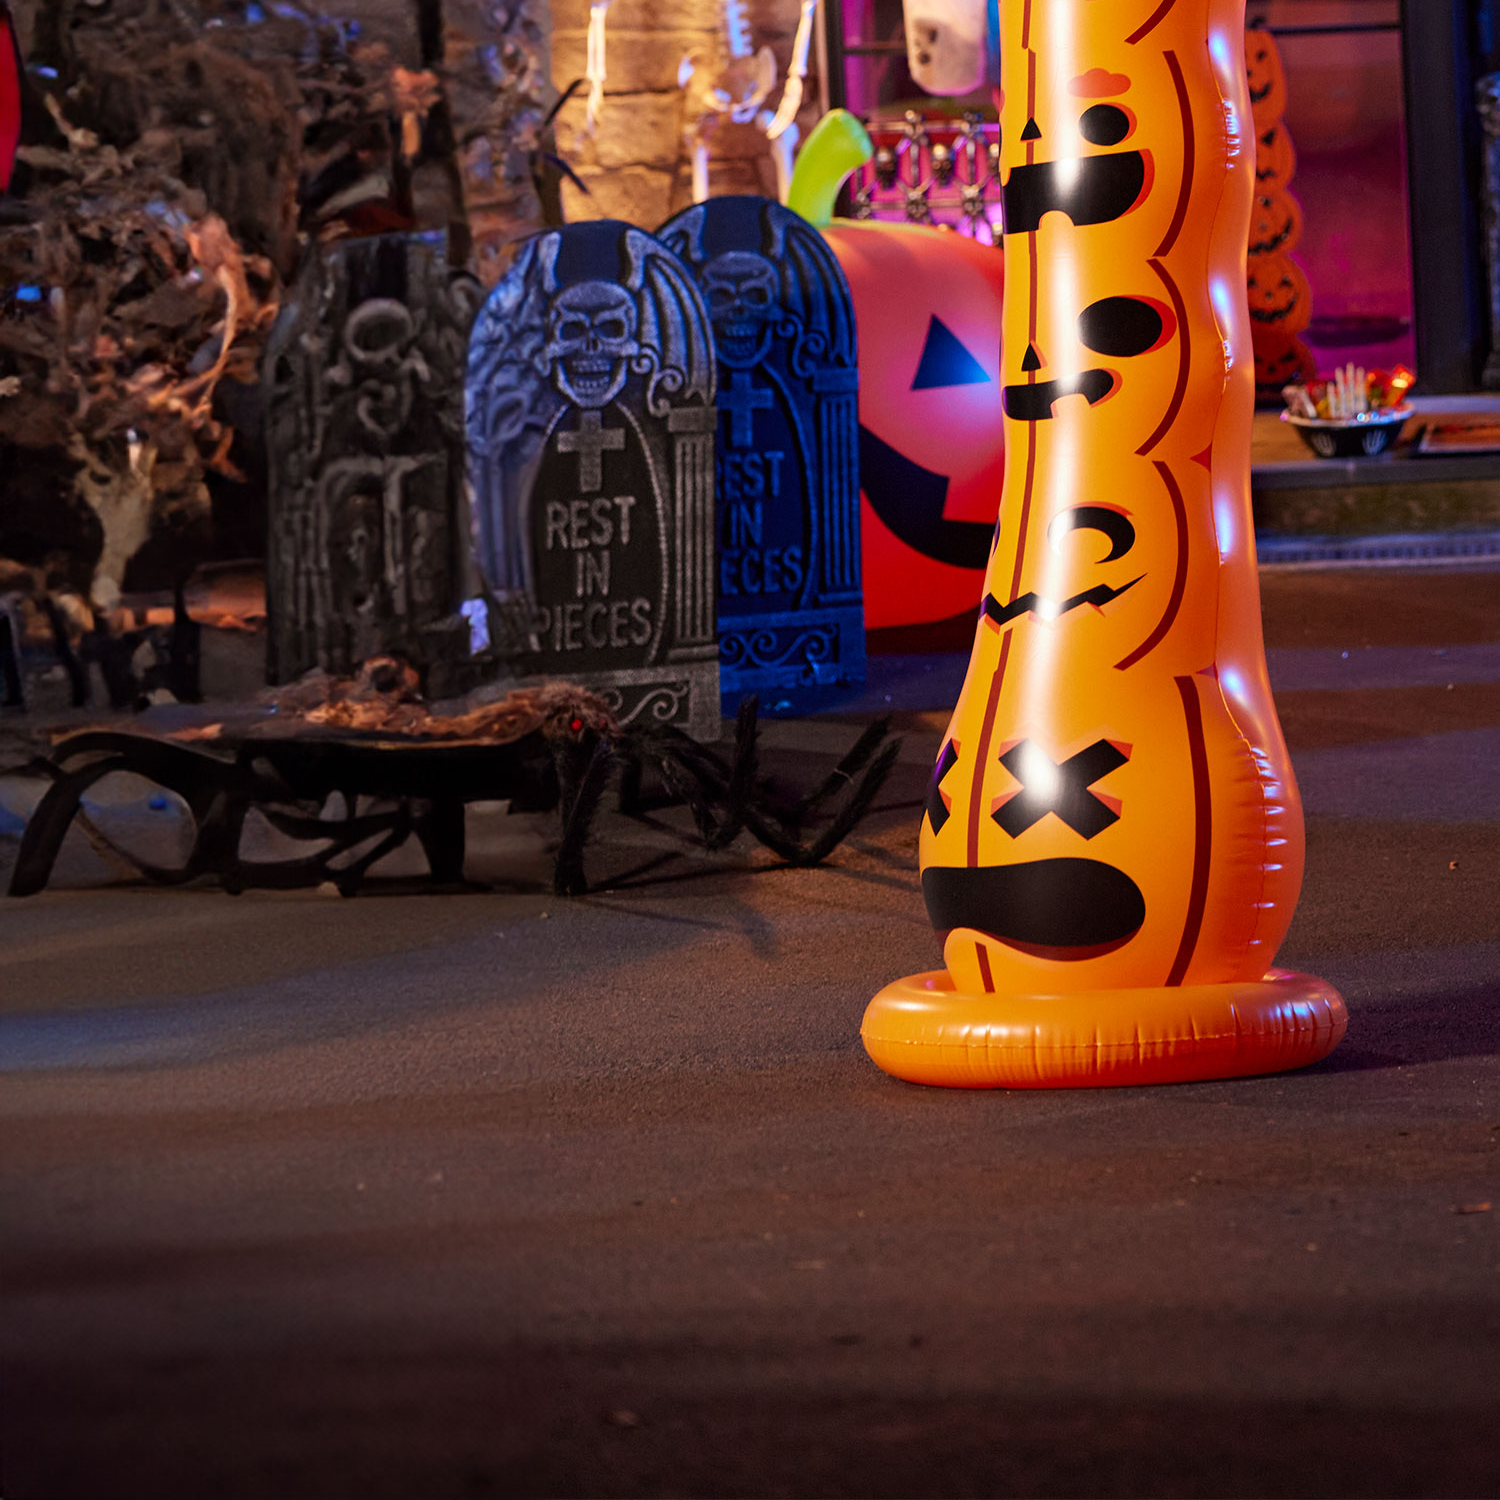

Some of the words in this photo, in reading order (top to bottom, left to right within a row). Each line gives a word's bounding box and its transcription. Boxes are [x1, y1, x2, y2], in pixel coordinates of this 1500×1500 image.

[545, 495, 636, 550] REST
[730, 501, 763, 548] IN
[575, 550, 611, 598] IN
[719, 545, 803, 595] ECES
[528, 597, 652, 653] PIECES
